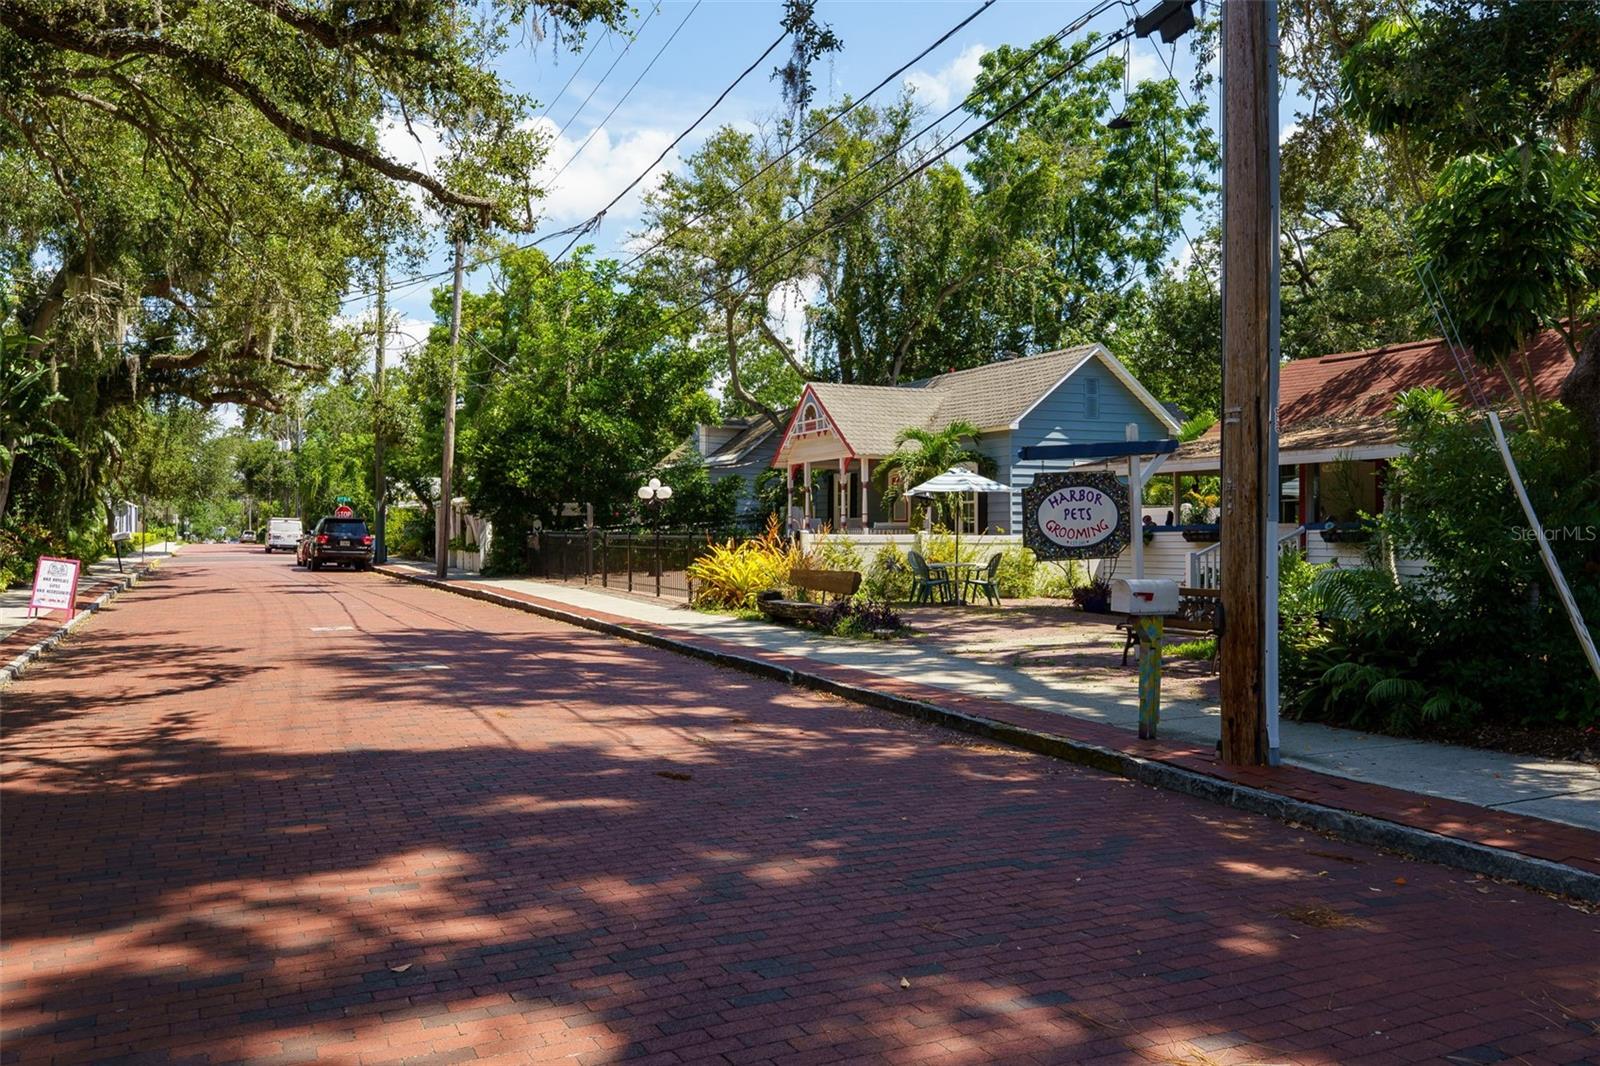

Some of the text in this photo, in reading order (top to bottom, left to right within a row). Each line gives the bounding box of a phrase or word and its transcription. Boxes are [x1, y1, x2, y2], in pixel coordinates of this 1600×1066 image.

[1048, 489, 1102, 508] HARBOR
[336, 511, 352, 519] STOP
[1064, 508, 1091, 520] PETS
[1046, 519, 1108, 539] GROOMING
